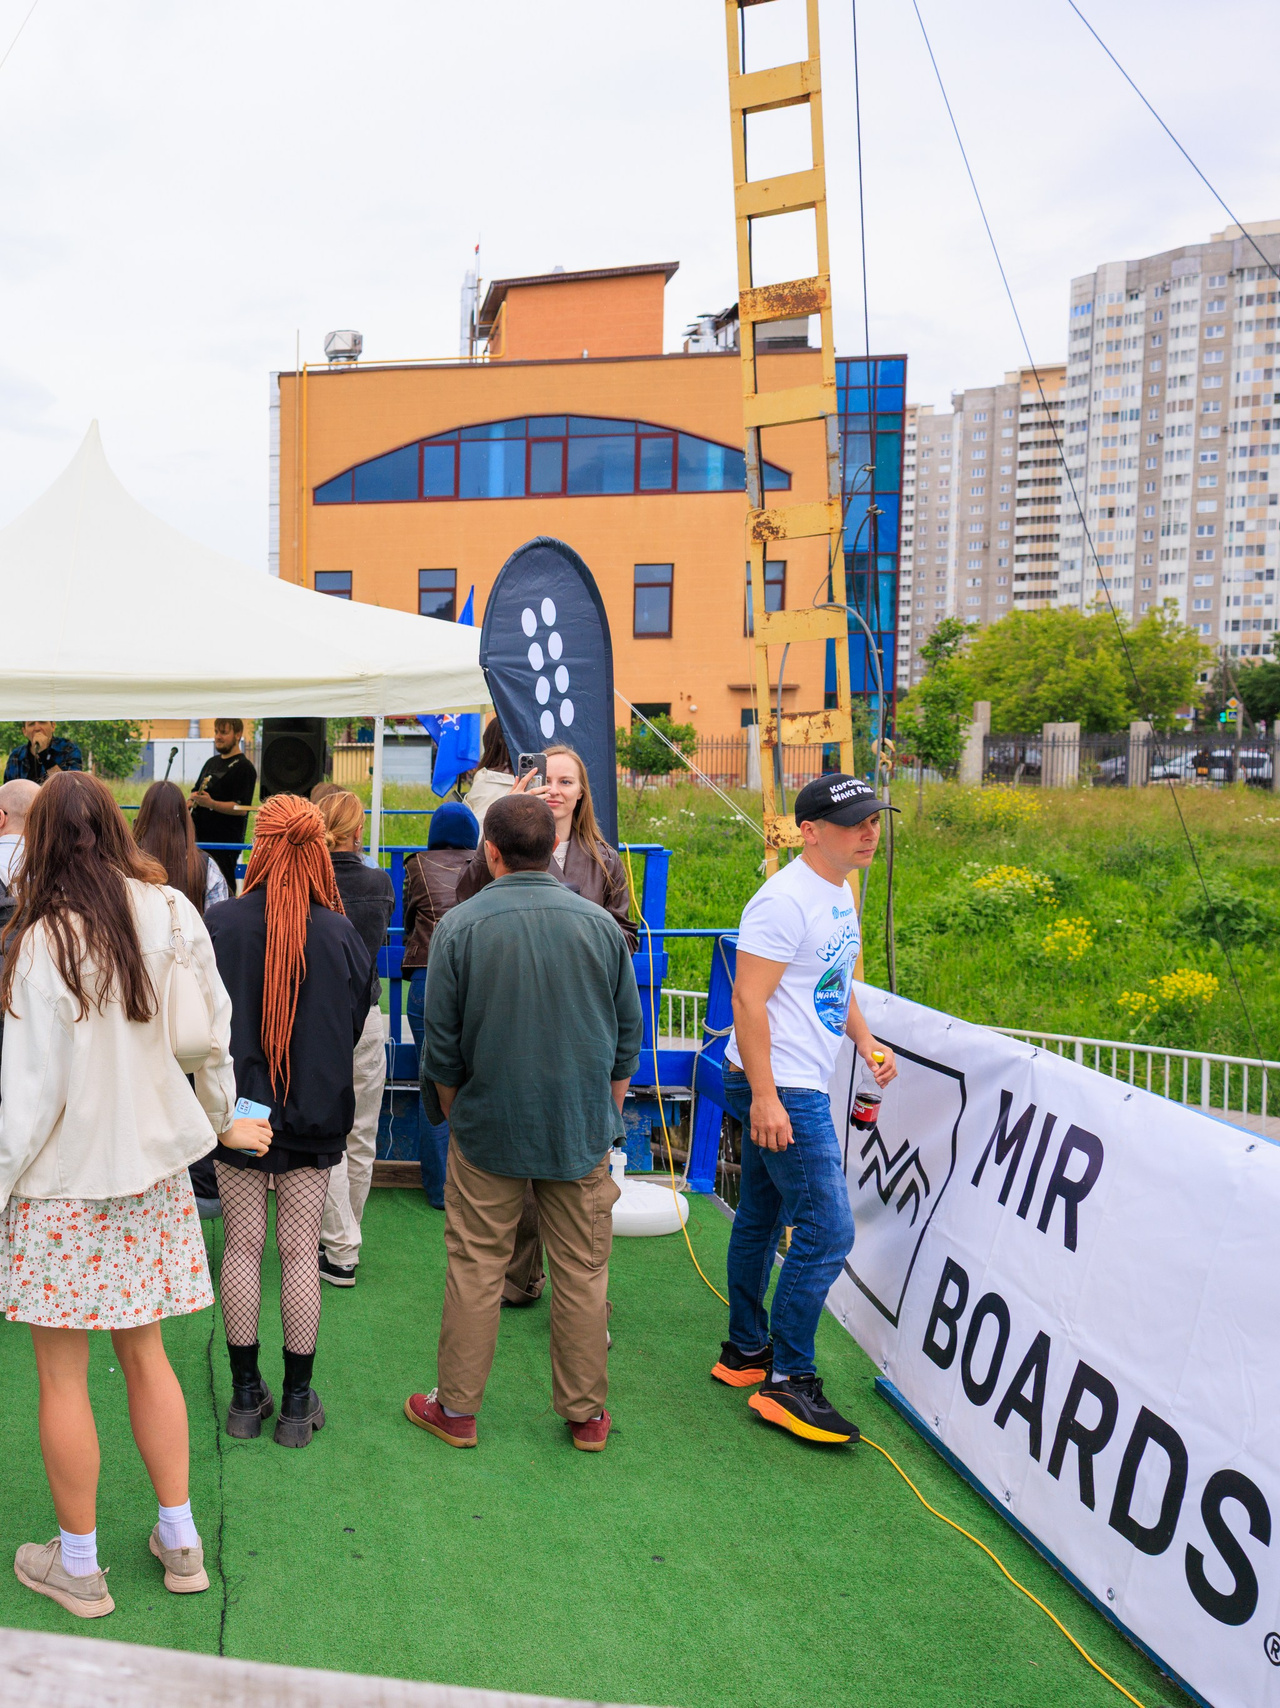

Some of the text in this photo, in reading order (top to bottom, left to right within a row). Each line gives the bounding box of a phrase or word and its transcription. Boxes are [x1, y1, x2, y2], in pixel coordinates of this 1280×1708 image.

[831, 789, 857, 803] WAKE
[816, 989, 839, 1000] WAKE
[971, 1088, 1104, 1253] MIR
[922, 1256, 1272, 1626] BOARDS
